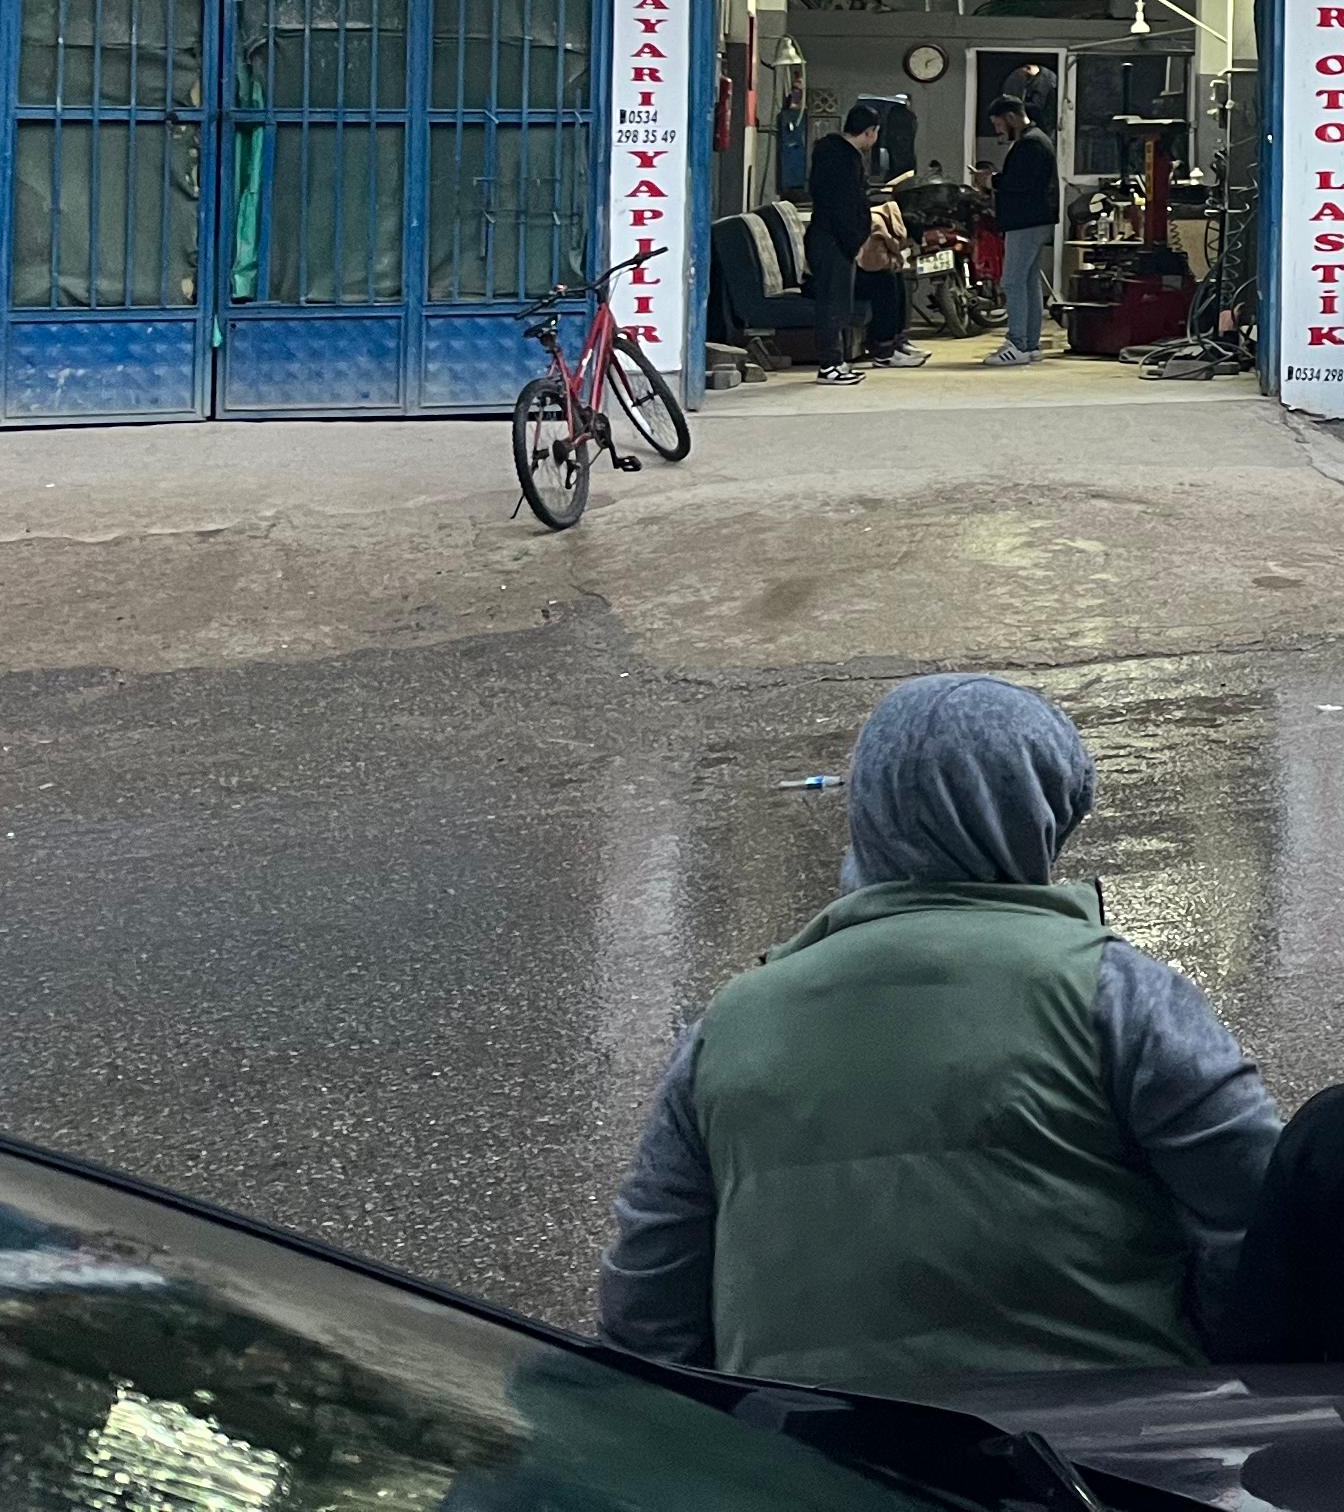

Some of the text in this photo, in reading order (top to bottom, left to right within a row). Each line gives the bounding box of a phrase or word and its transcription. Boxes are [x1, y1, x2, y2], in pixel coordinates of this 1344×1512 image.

[628, 109, 658, 125] 0534
[616, 128, 677, 144] 298 35 49
[622, 151, 668, 345] YAPILIR
[1295, 367, 1321, 382] 0534
[1324, 368, 1344, 382] 298
